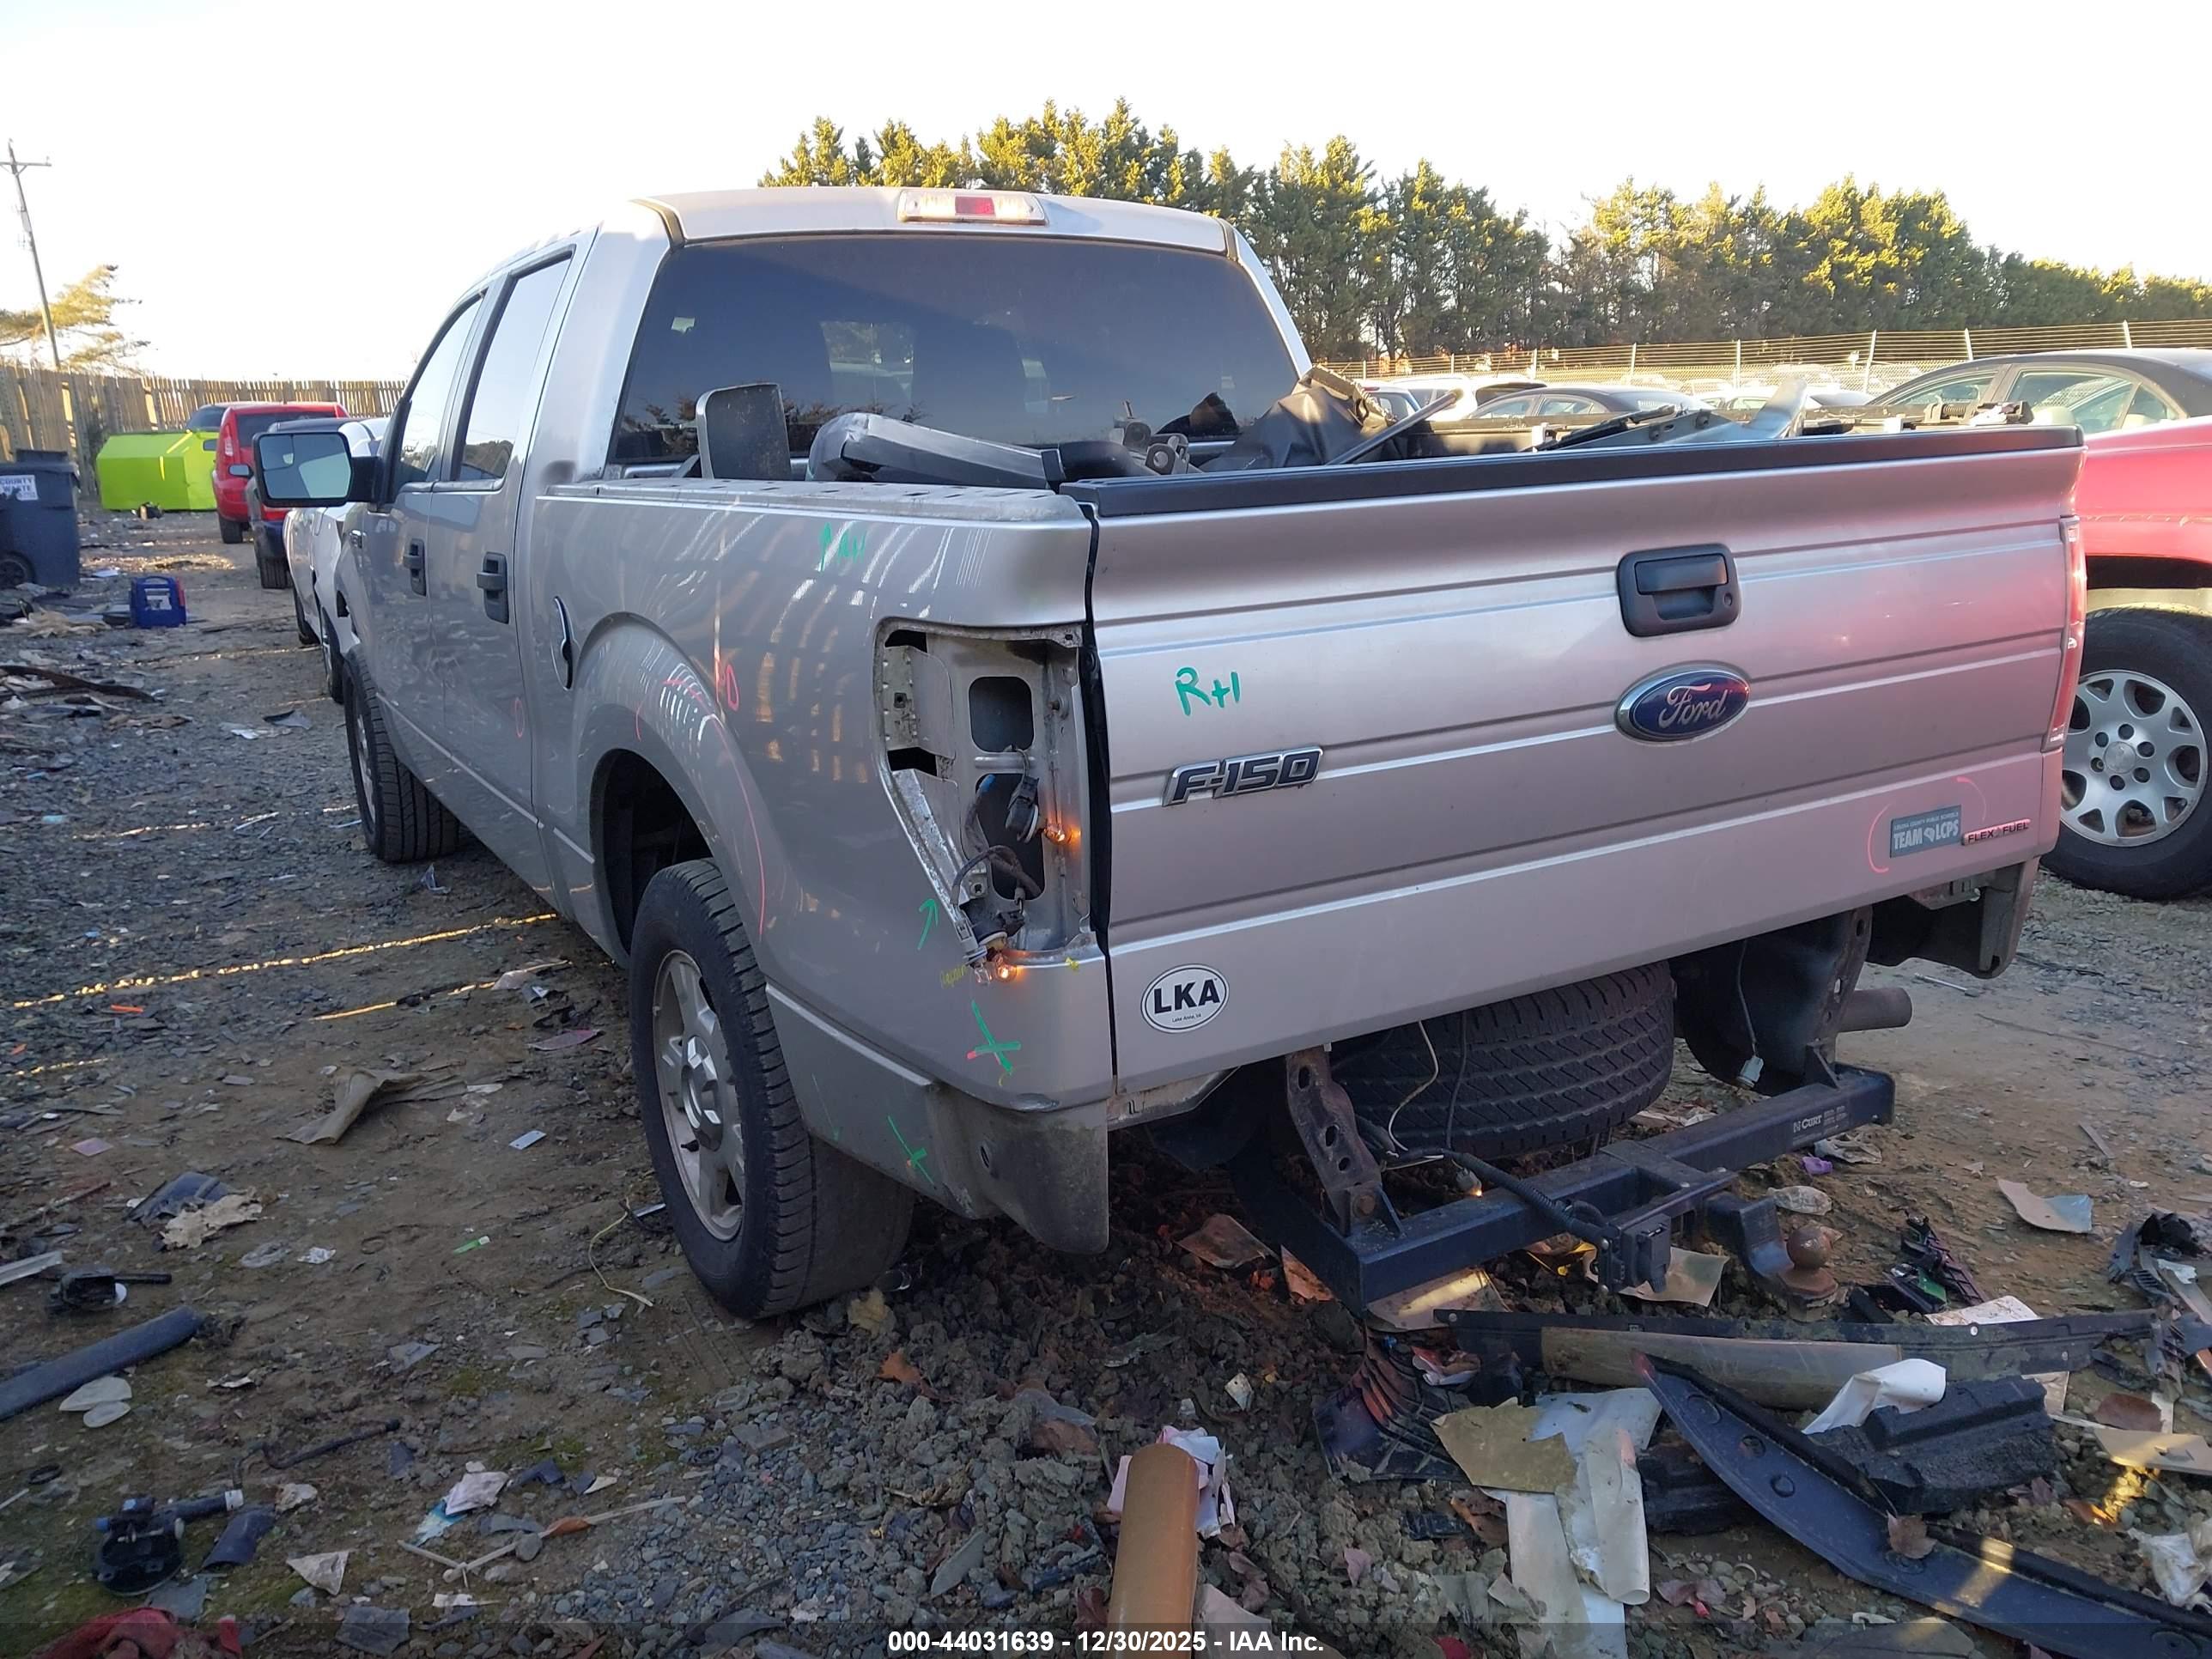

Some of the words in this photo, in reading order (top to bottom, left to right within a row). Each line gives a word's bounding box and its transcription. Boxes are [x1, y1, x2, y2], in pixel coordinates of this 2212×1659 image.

[1658, 683, 1728, 728] Ford
[1162, 745, 1323, 807] F-150
[1893, 826, 1923, 850] TEAM
[1936, 819, 1959, 841] LCPS
[1967, 830, 1994, 843] FLEX
[2002, 822, 2029, 835] FUEL
[1154, 979, 1220, 1014] LKA
[1802, 1115, 1822, 1129] CURT
